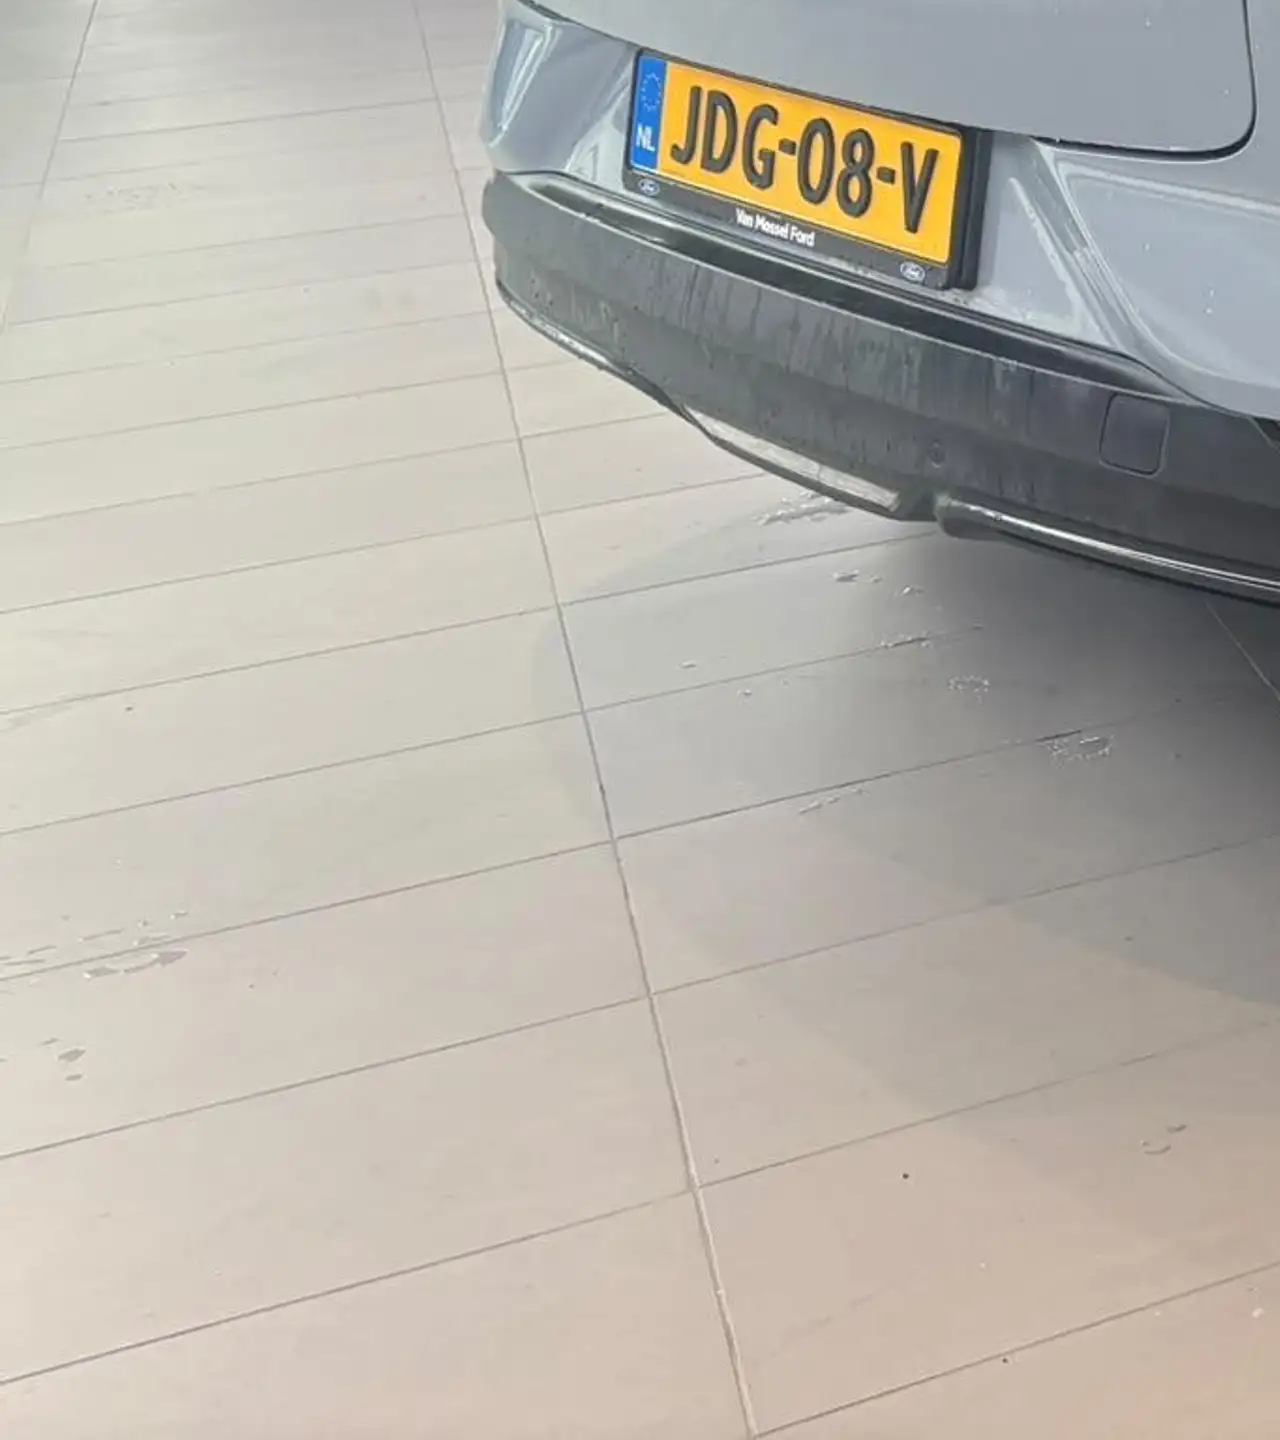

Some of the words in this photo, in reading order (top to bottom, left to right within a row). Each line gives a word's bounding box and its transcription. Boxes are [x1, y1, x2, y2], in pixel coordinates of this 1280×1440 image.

[636, 124, 656, 152] NL
[670, 85, 940, 235] JDG-08-V
[736, 207, 754, 228] Van
[790, 225, 816, 247] Ford
